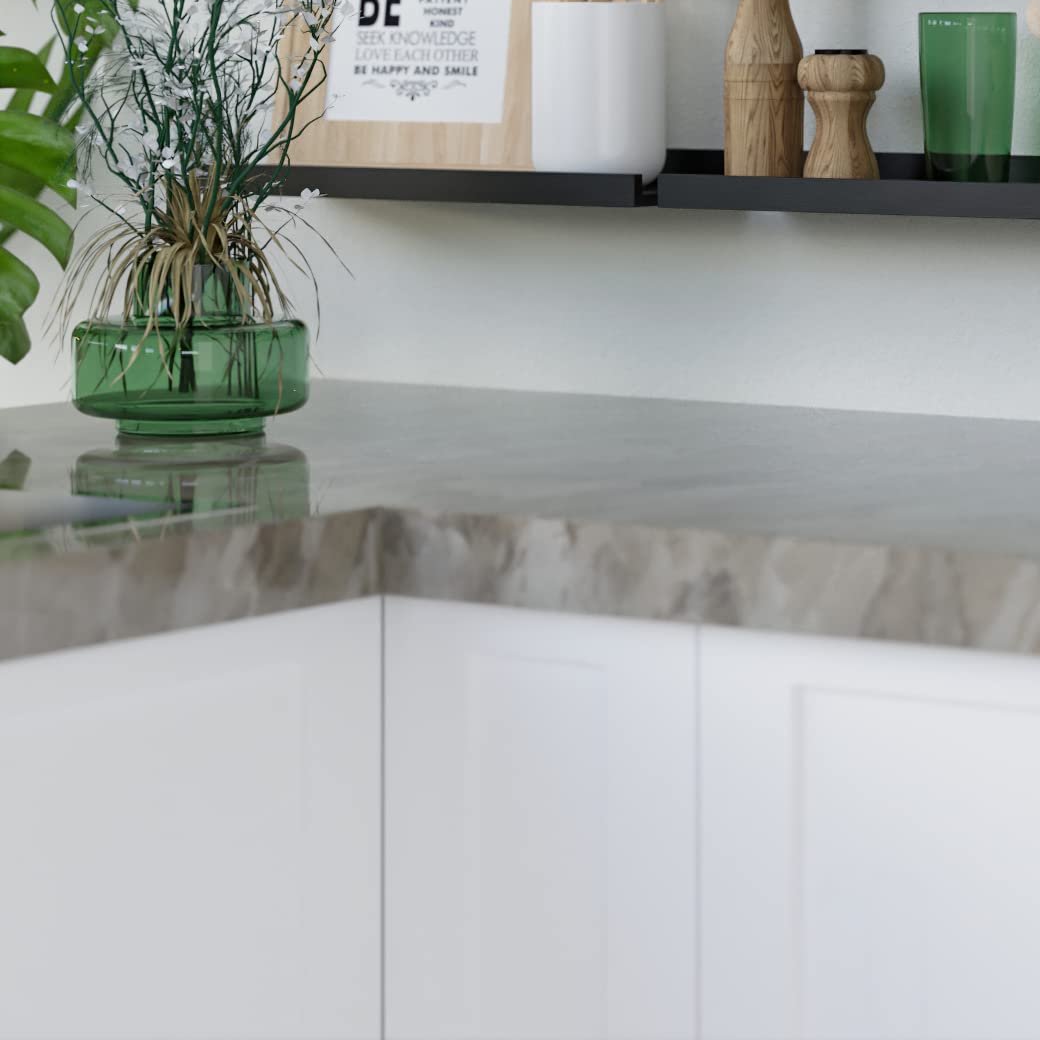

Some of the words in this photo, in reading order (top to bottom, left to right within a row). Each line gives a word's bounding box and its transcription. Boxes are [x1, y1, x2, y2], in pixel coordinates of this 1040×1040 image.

[423, 7, 463, 16] HONEST
[429, 19, 455, 28] KIND
[353, 65, 367, 76] BE
[371, 65, 409, 76] HAPPY
[413, 65, 440, 76] AND
[444, 65, 479, 77] SMILE
